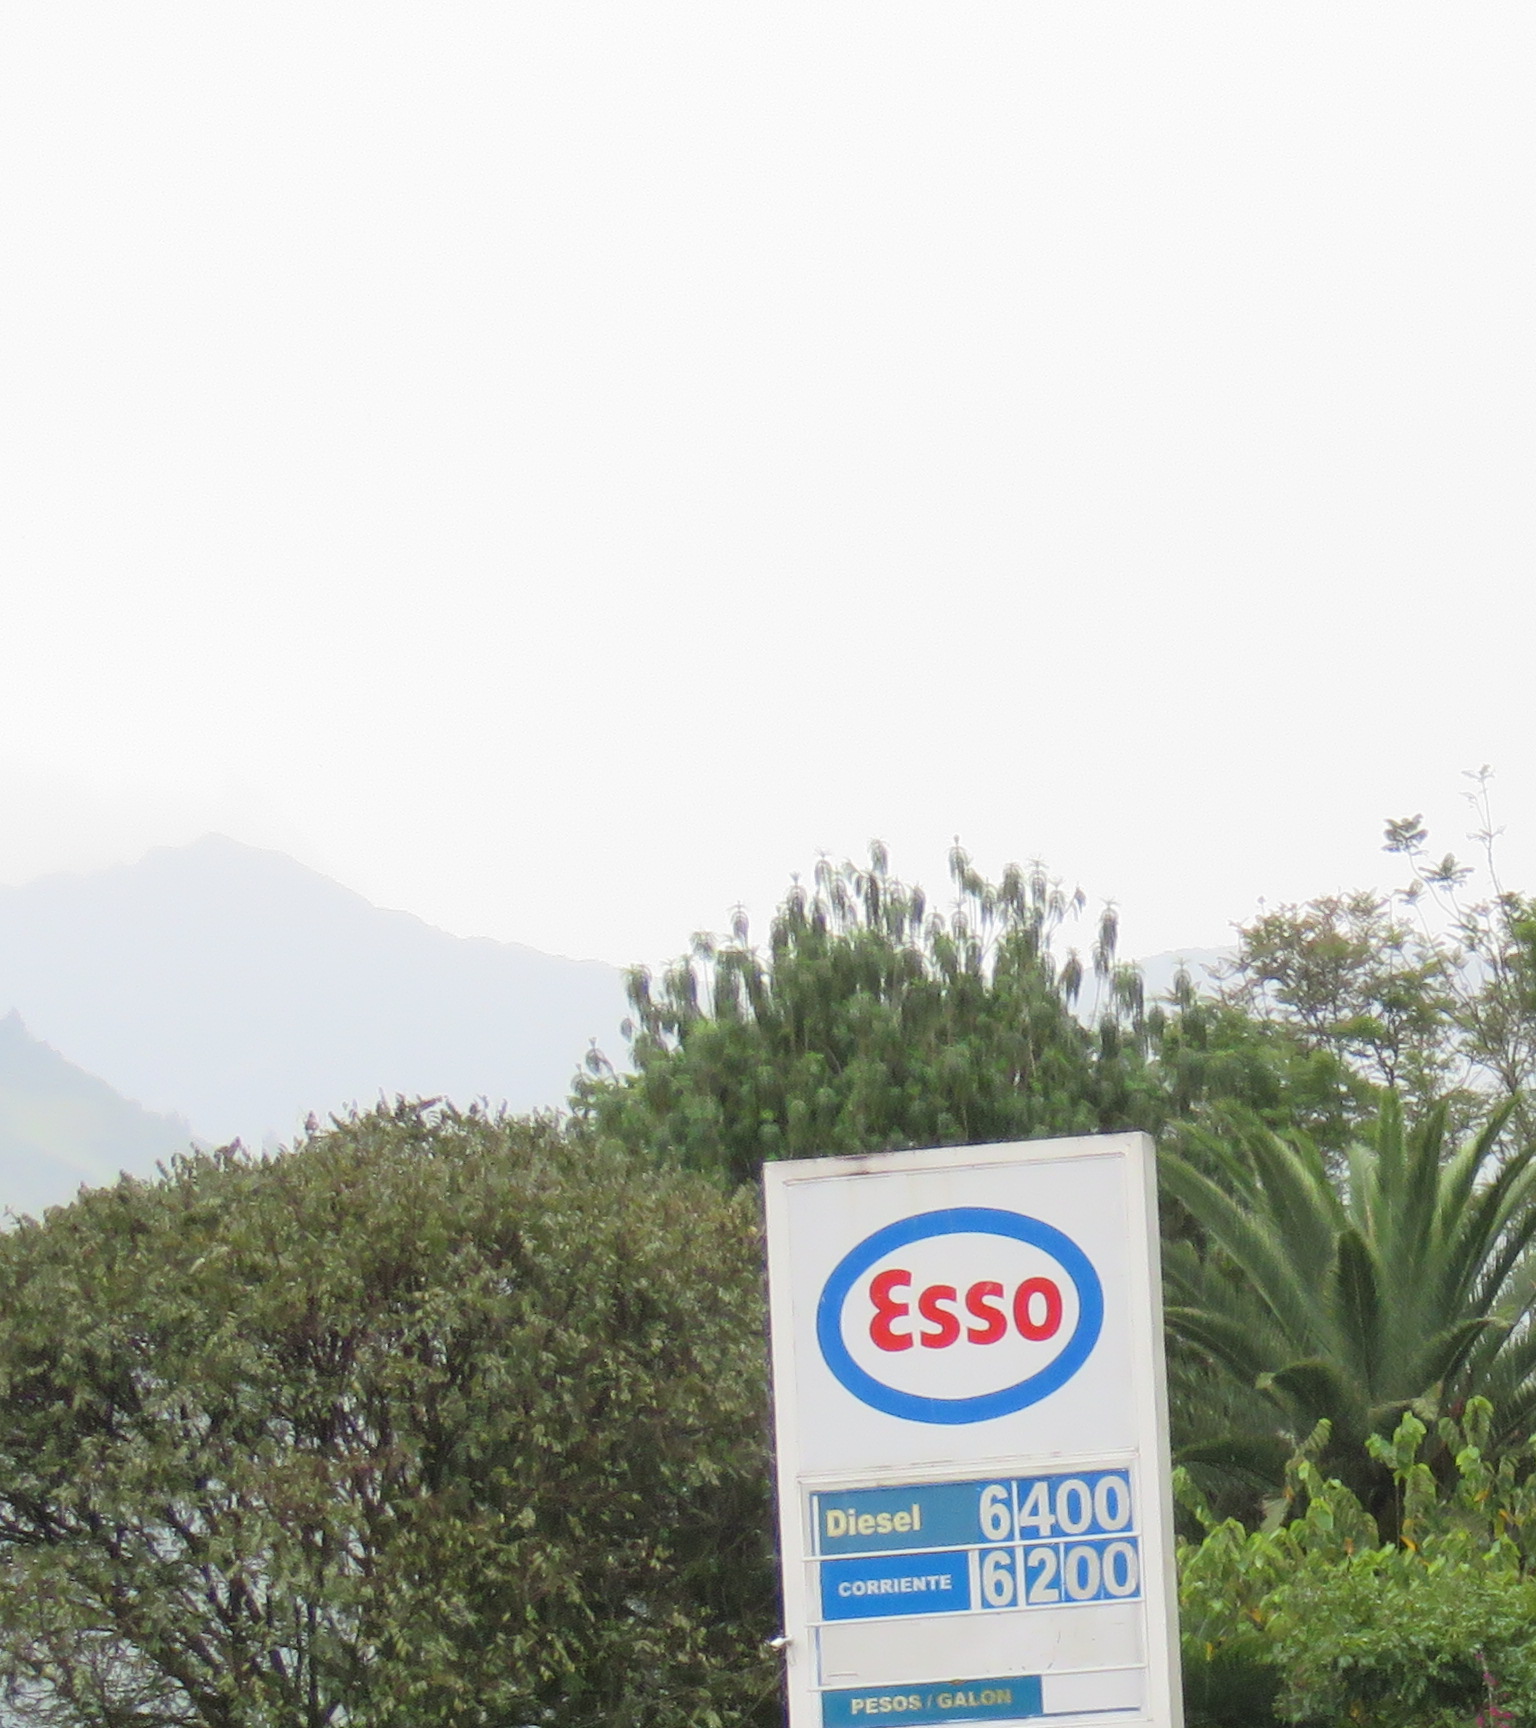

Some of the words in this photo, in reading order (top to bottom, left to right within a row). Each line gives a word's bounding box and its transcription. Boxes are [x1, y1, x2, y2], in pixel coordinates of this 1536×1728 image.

[826, 1504, 921, 1538] Diesel
[980, 1475, 1131, 1540] 6400
[838, 1574, 952, 1598] CORRIENTE
[982, 1542, 1138, 1607] 6200
[851, 1695, 922, 1715] PESOS
[937, 1689, 1012, 1709] GALON
